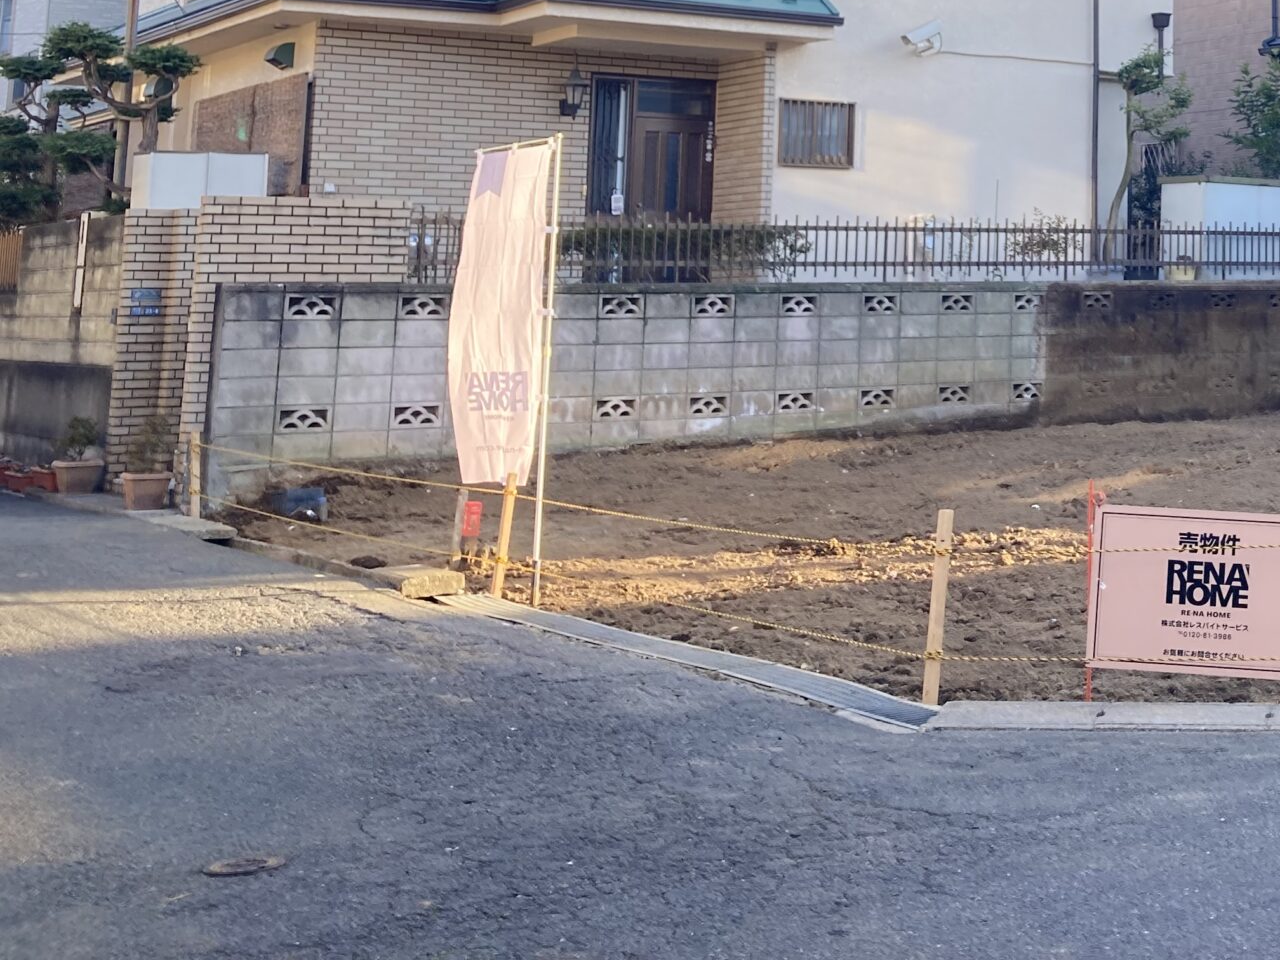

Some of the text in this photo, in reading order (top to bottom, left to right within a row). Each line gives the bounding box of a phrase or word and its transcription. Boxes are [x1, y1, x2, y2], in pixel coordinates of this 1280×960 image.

[1179, 532, 1241, 556] 売物件
[1168, 559, 1249, 589] RENA
[1166, 581, 1248, 608] HOME
